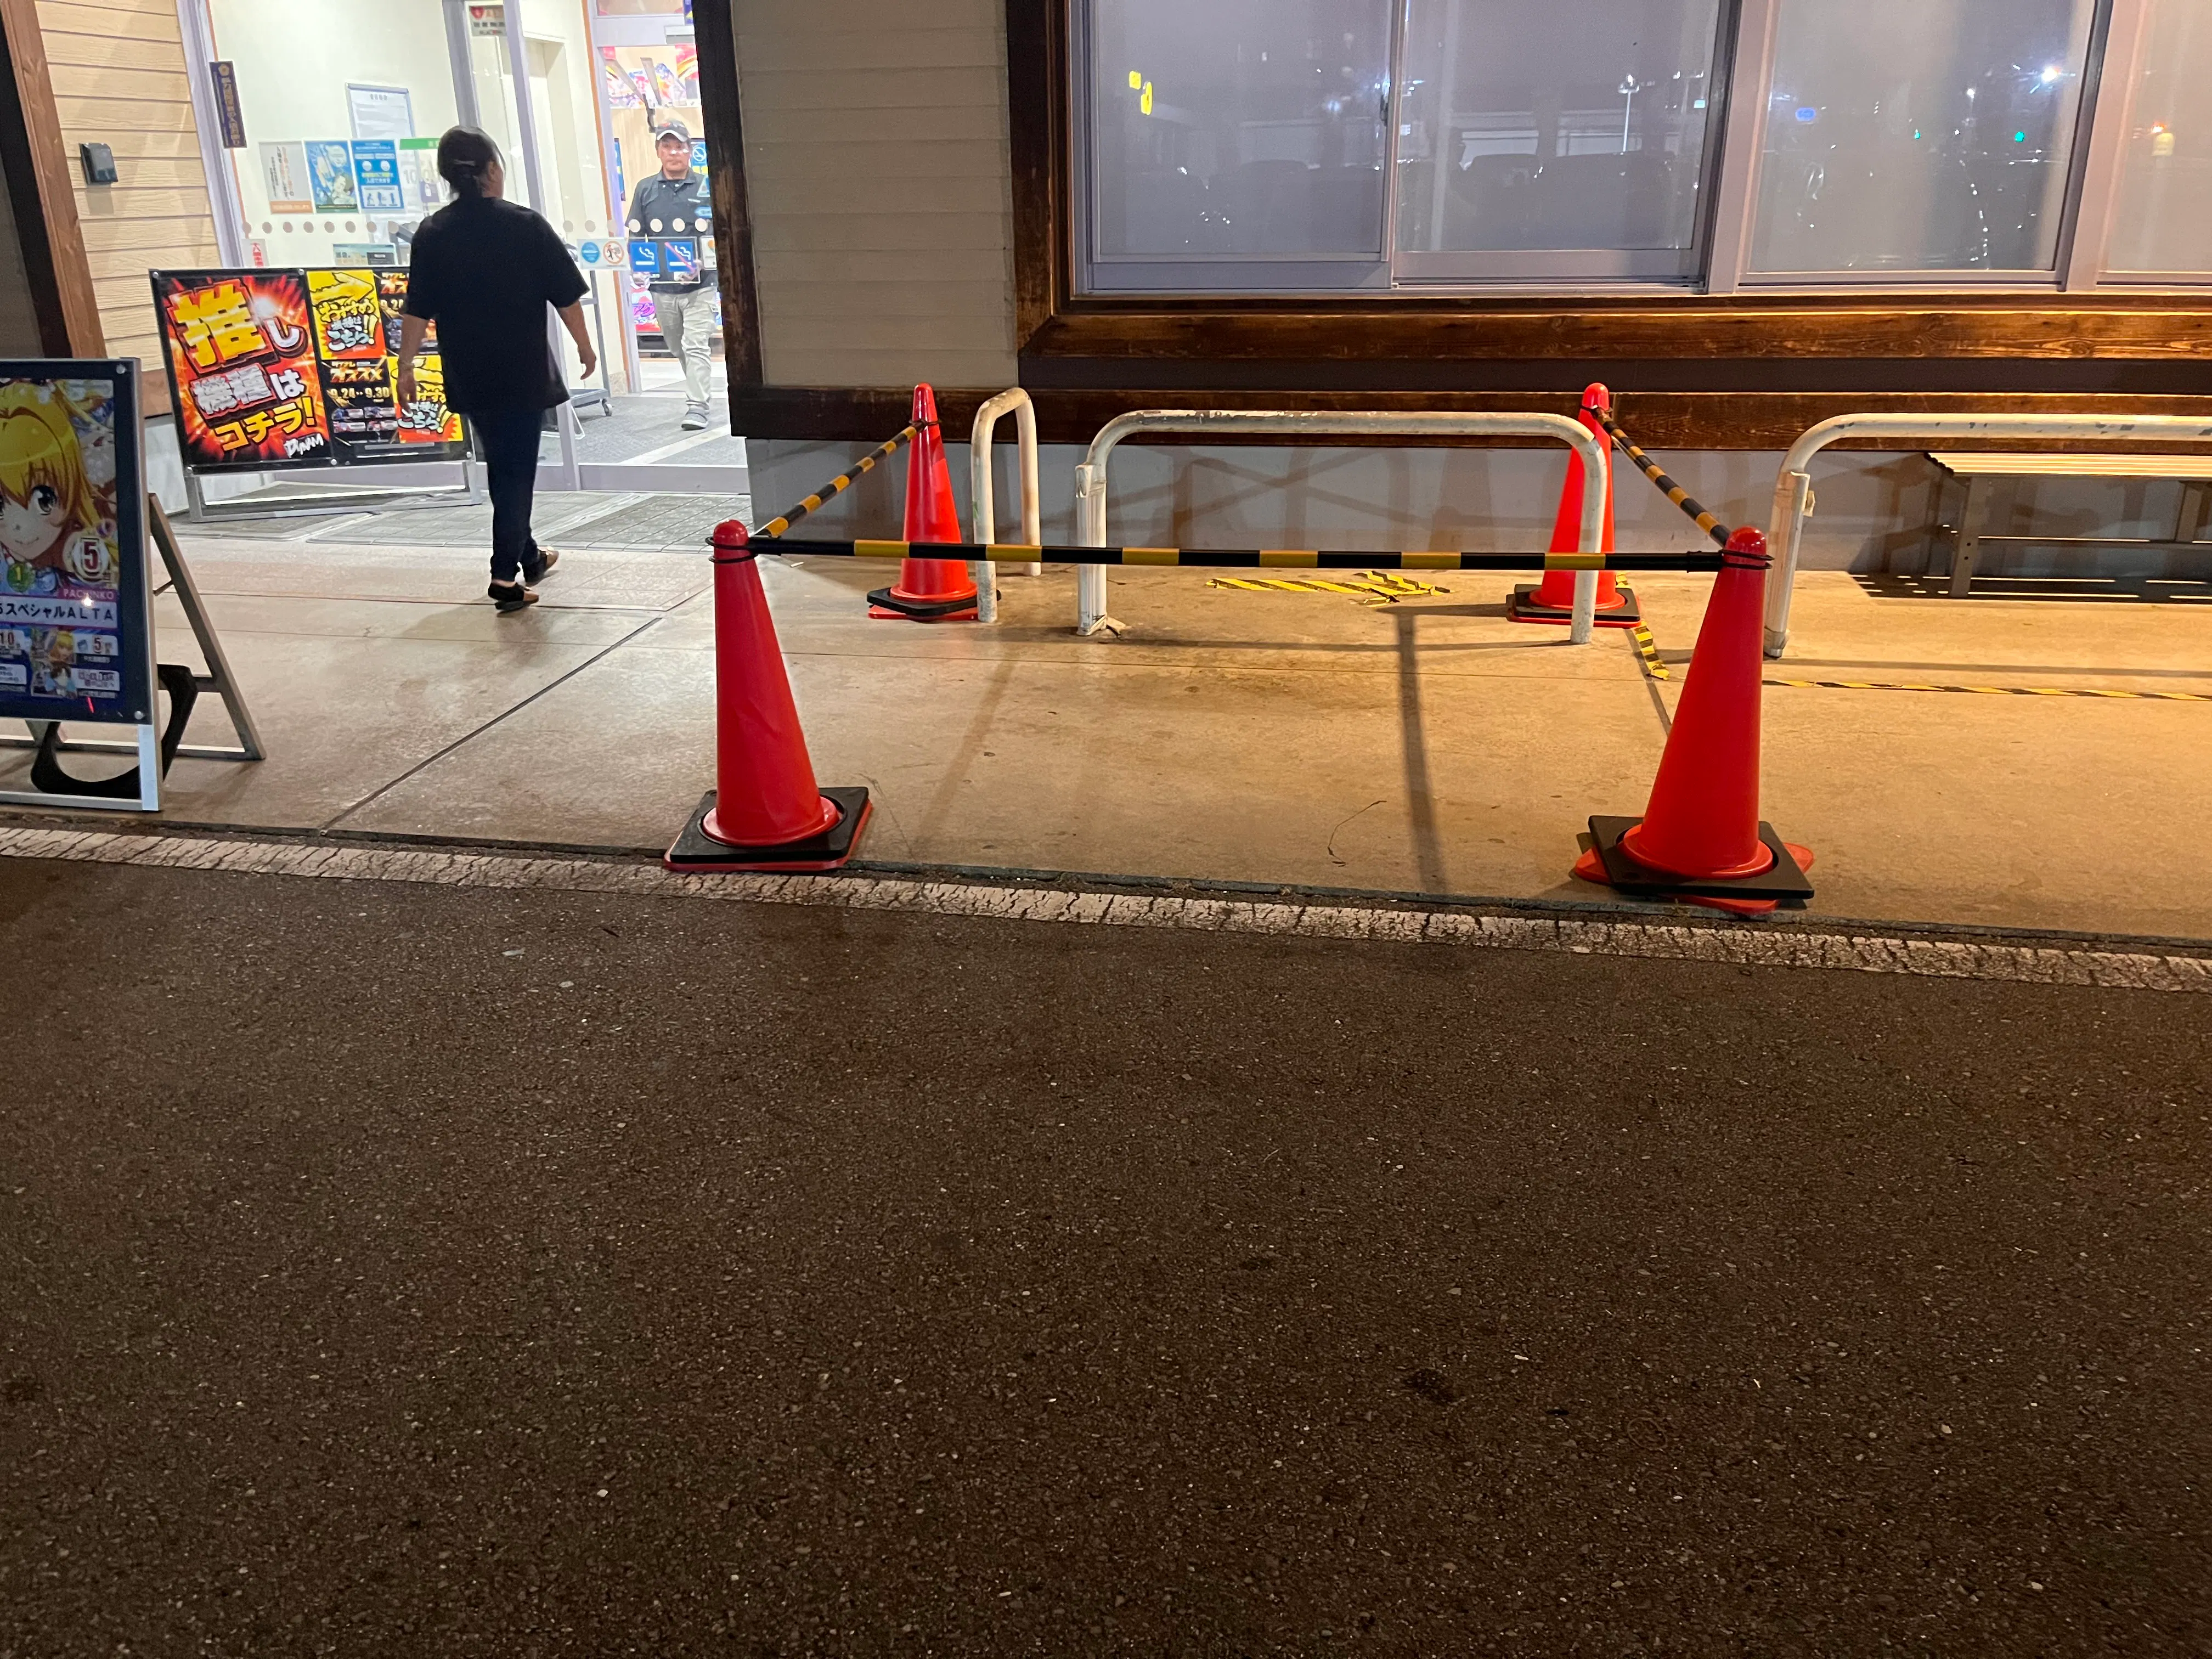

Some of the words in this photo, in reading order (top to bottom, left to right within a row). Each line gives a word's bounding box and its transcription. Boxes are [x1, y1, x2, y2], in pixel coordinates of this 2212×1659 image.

[173, 284, 300, 367] 推し
[193, 369, 304, 415] 機種は
[215, 397, 315, 452] コチラ!
